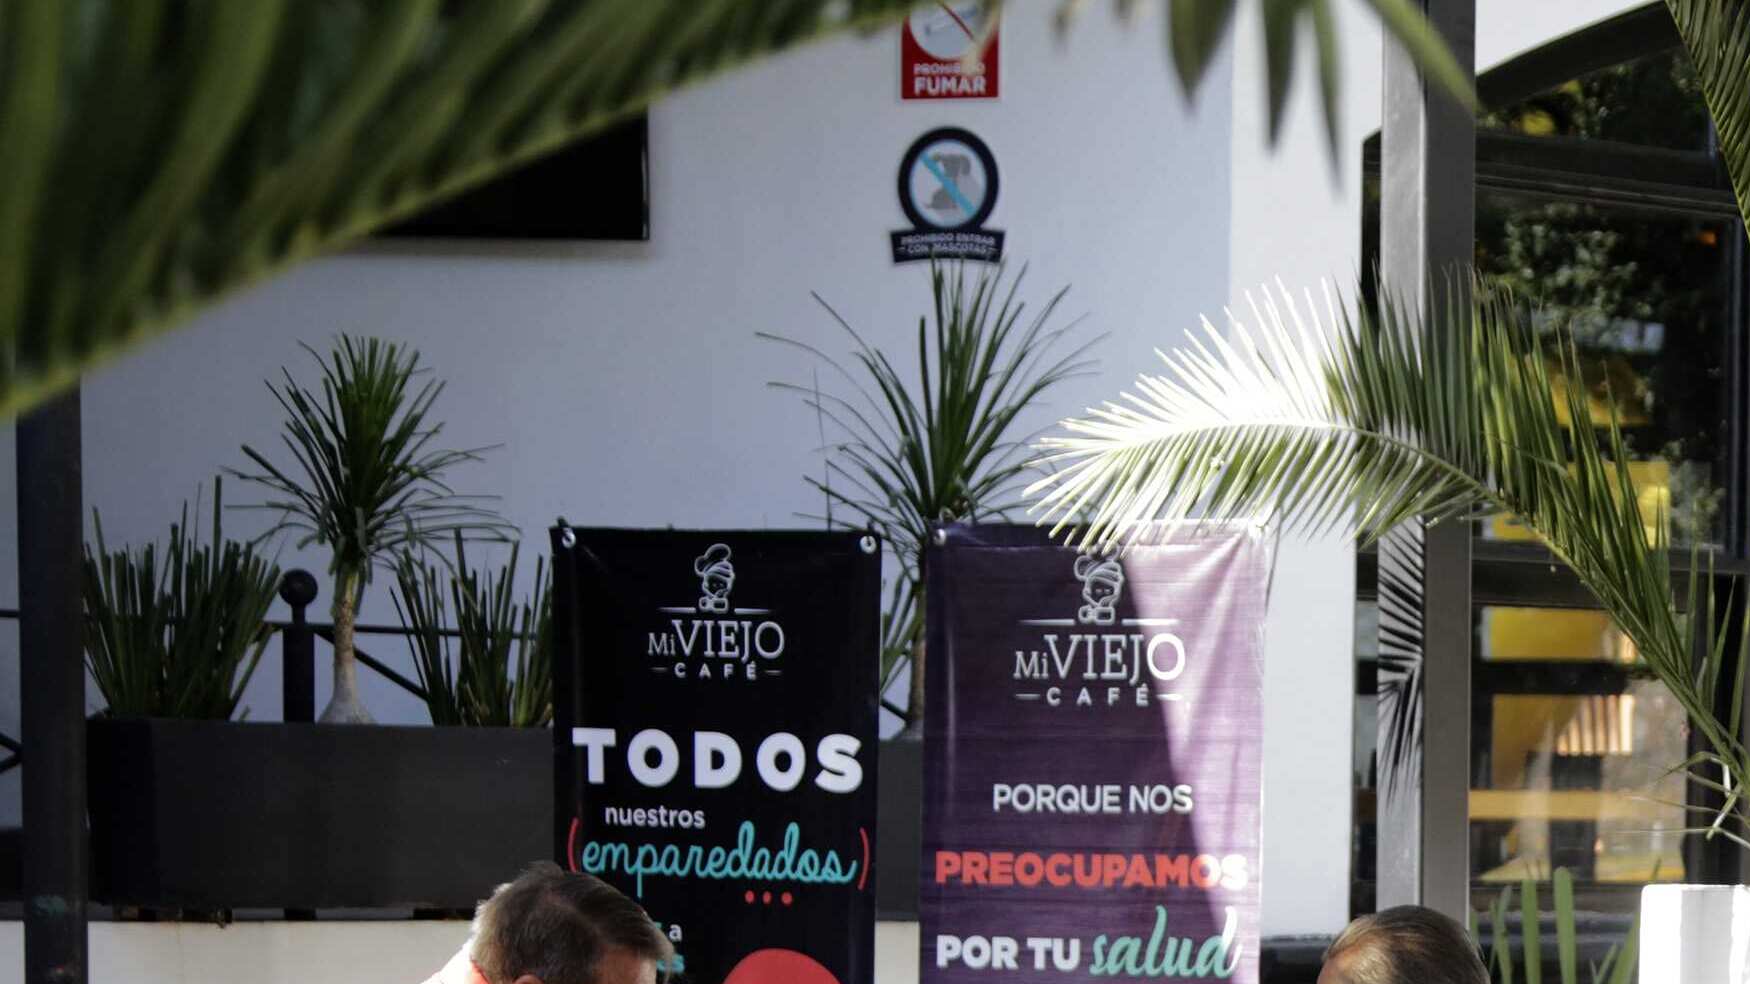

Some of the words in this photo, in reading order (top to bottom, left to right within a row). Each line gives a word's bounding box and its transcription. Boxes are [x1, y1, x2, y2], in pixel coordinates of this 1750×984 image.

[913, 62, 986, 74] PROHIBO
[914, 75, 987, 96] FUMAR
[901, 233, 954, 245] PROHIBIDO
[957, 233, 995, 246] ENTRAR
[907, 244, 929, 254] CON
[934, 243, 987, 255] MASCOTAS
[672, 619, 785, 664] VIEJO
[674, 660, 757, 680] CAFÉ
[1043, 632, 1186, 685] VIEJO
[1046, 683, 1149, 706] CAFÉ
[572, 726, 864, 794] TODOS
[993, 783, 1121, 813] PORQUE
[1130, 784, 1194, 814] NOS
[605, 805, 706, 829] nuestros
[935, 850, 1248, 890] PREOCUPAMOS
[936, 934, 1018, 971] POR
[1027, 937, 1081, 971] TU
[1089, 904, 1242, 978] salud
